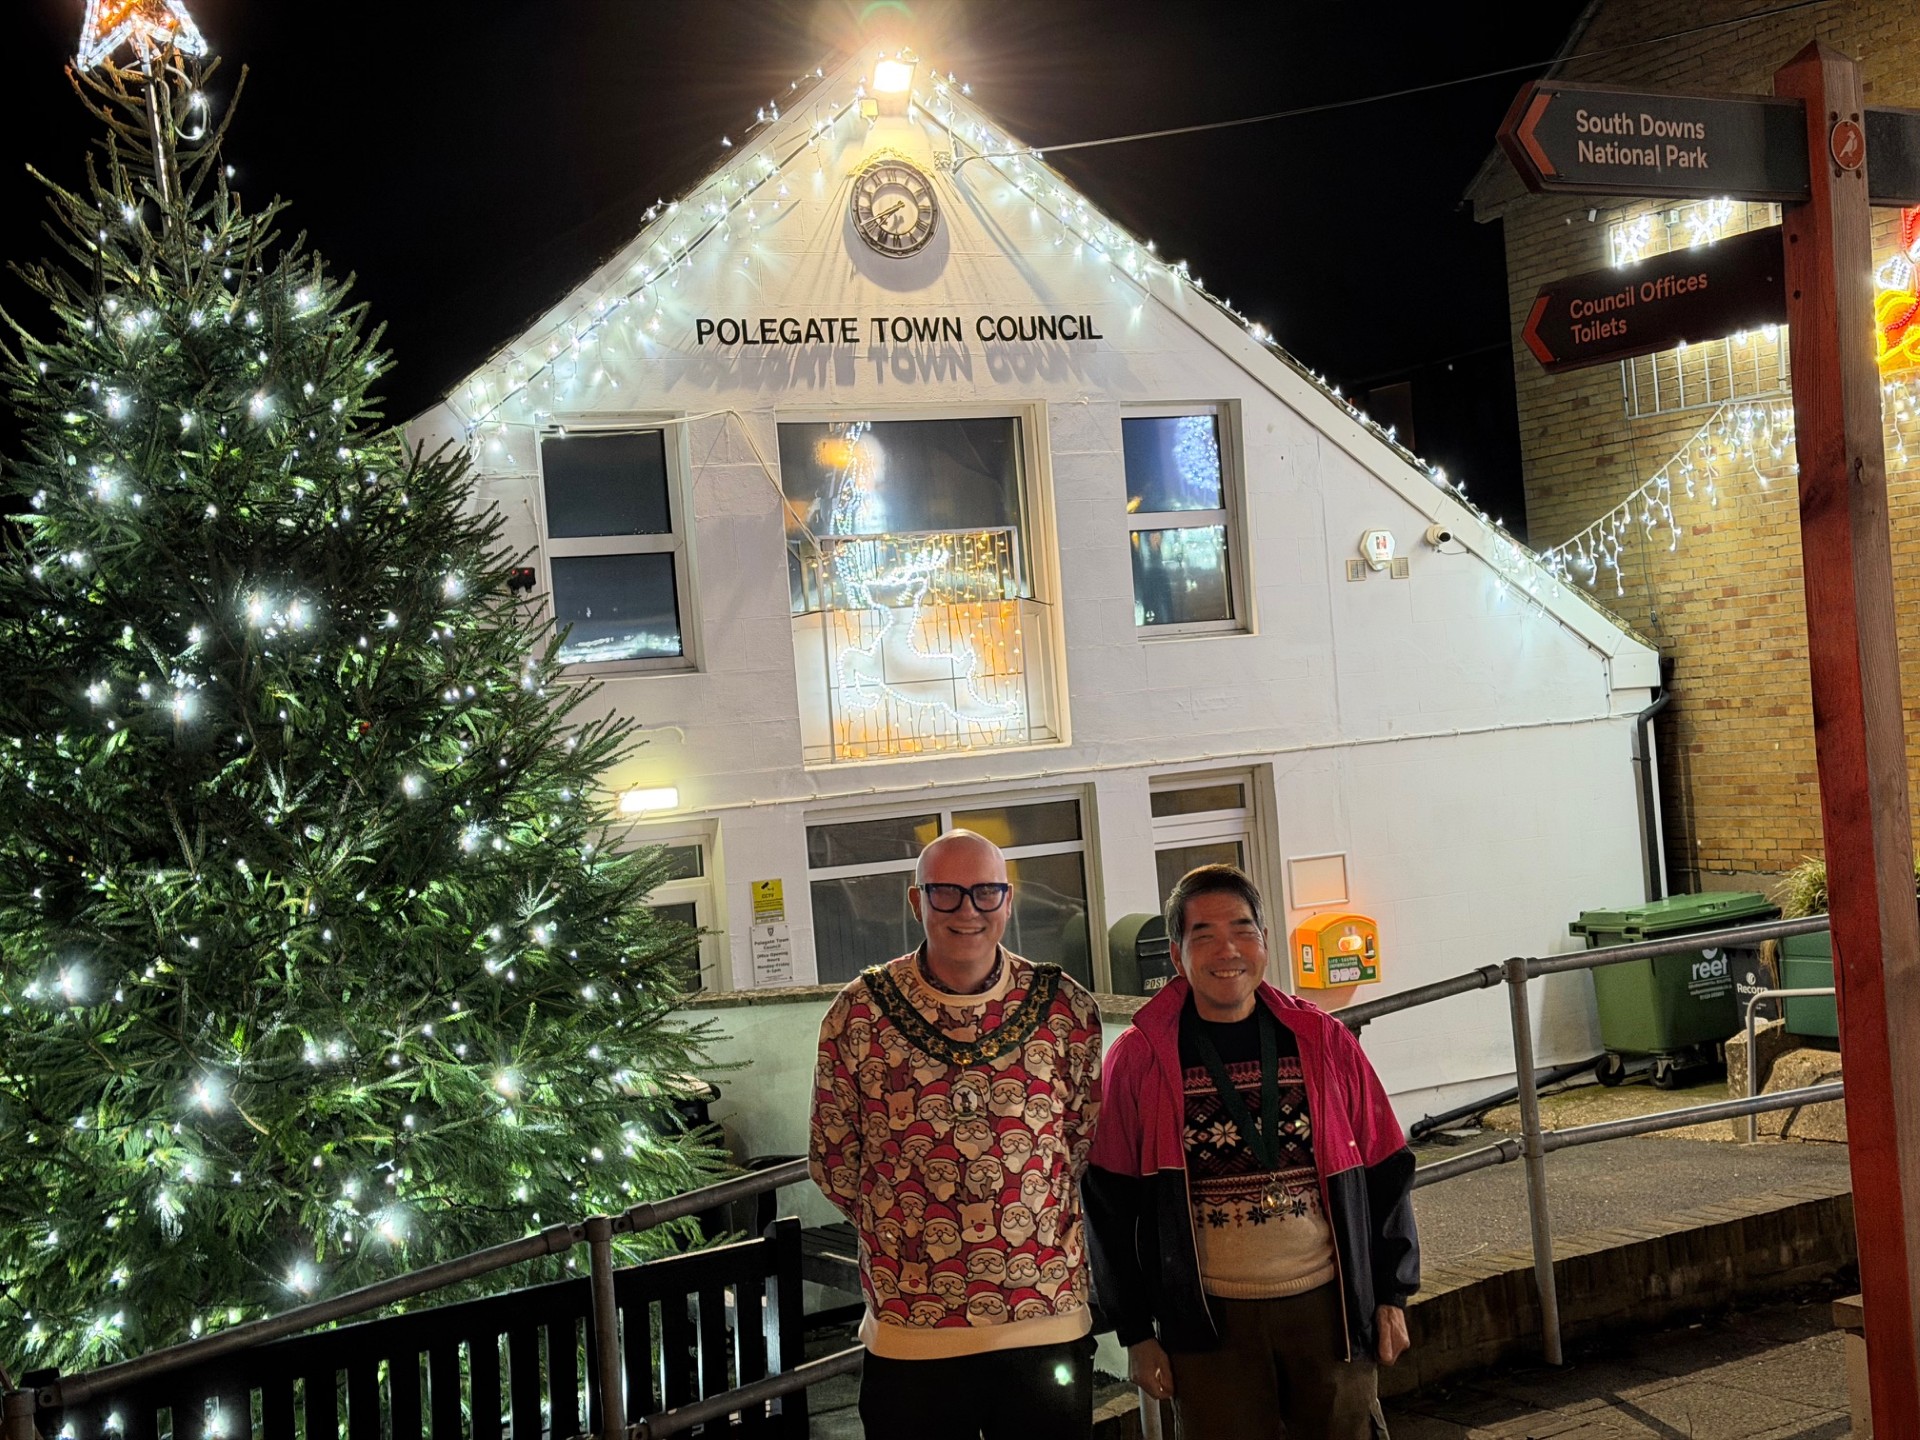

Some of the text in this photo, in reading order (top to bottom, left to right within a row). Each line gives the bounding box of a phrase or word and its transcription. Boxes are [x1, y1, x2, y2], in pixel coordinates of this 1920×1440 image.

[1576, 108, 1706, 140] South Downs
[1578, 139, 1709, 170] National Park
[1569, 271, 1709, 321] Council Offices
[696, 314, 1104, 346] POLEGATE TOWN COUNCIL
[1570, 317, 1628, 345] Toilets
[1145, 977, 1167, 988] POST
